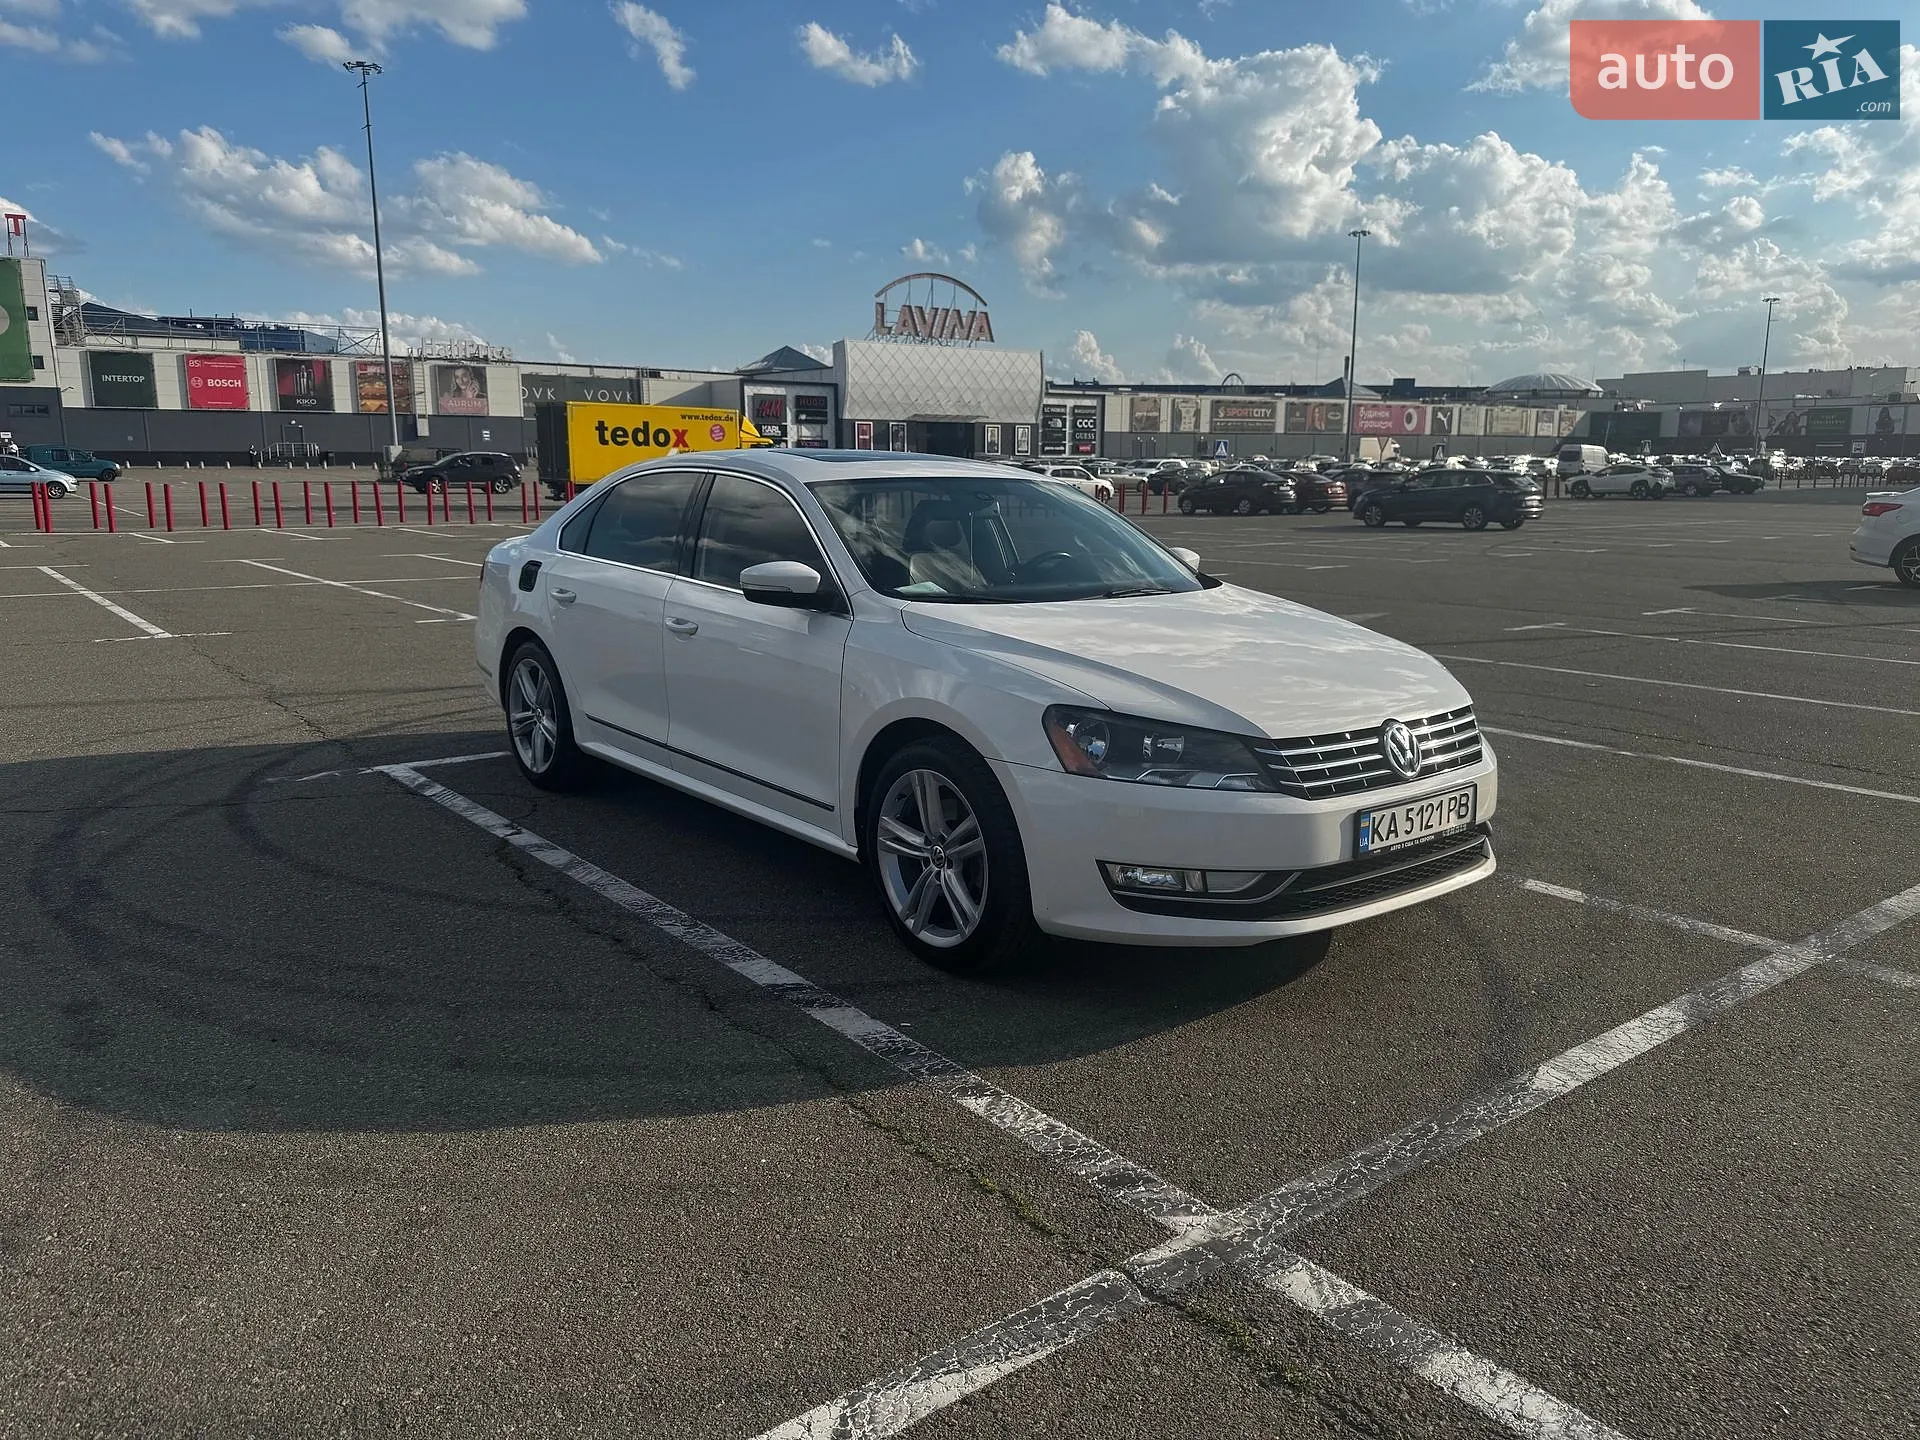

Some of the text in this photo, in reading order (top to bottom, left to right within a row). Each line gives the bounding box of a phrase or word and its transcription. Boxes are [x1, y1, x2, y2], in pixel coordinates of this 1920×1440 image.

[875, 302, 995, 342] LAVINA
[102, 374, 145, 383] INTERTOP
[207, 378, 241, 387] BOSCH
[521, 386, 556, 400] OVK
[584, 389, 632, 402] VOVK
[447, 399, 483, 408] AURUM
[1226, 406, 1272, 418] SPORTCITY
[680, 413, 734, 422] www.tedox.de
[1076, 419, 1095, 428] CCC
[595, 420, 689, 448] tedox
[761, 425, 781, 434] KARL
[1075, 432, 1095, 440] GUESS
[1371, 812, 1399, 845] KA
[1404, 800, 1443, 835] 5121
[1447, 793, 1470, 824] PB
[1360, 837, 1368, 847] UA
